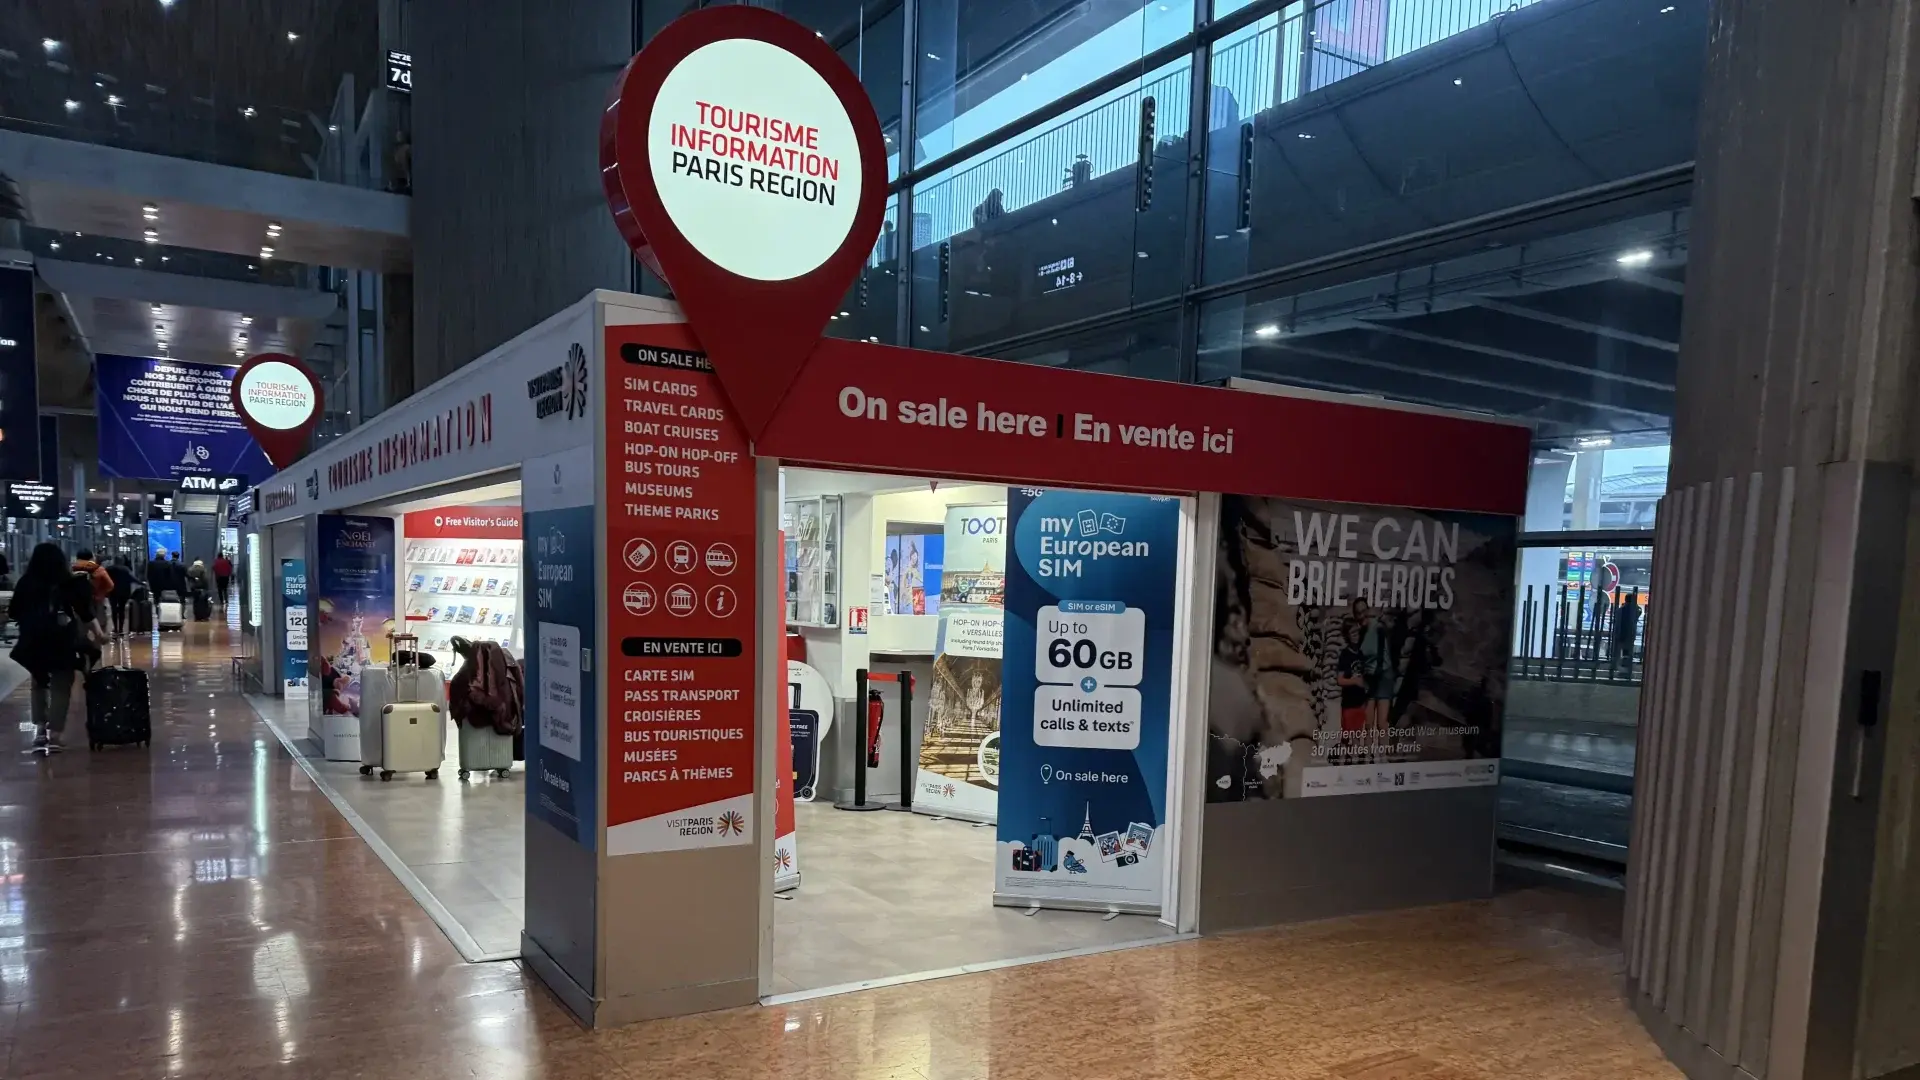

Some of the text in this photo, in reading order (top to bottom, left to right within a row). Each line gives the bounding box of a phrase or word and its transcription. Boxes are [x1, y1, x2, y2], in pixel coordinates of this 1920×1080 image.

[696, 100, 819, 151] TOURISME
[671, 123, 839, 181] INFORMATION
[672, 151, 835, 207] PARIS REGION
[0, 336, 17, 346] on
[638, 349, 657, 364] ON
[660, 352, 693, 368] SALE
[154, 365, 187, 374] DEPUIS
[188, 368, 200, 376] 80
[130, 379, 231, 395] CONTRIBUENT À QUEL
[145, 372, 232, 387] NOS 26 AÉROPORTS
[256, 382, 299, 392] TOURISME
[624, 377, 698, 397] SIM CARDS
[123, 394, 149, 402] NOUS
[157, 396, 169, 404] UN
[171, 398, 200, 407] FUTUR
[127, 387, 230, 402] CHOSE DE PLUS GRAND
[248, 389, 307, 400] INFORMATION
[250, 396, 306, 407] PARIS REGION
[139, 403, 157, 411] QUI
[158, 405, 184, 414] NOUS
[185, 408, 210, 416] REND
[624, 399, 724, 421] TRAVEL CARDS
[838, 385, 1234, 454] On sale here En vente ici
[624, 421, 719, 442] BOAT CRUISES
[328, 392, 492, 493] TOURISME INFORMATION
[624, 442, 738, 464] HOP-ON HOP-OFF
[625, 461, 700, 478] BUS TOURS
[181, 477, 216, 490] ATM
[625, 482, 693, 499] MUSEUMS
[625, 503, 719, 521] THEME PARKS
[445, 517, 519, 527] Free Visitor's Guide
[1041, 517, 1073, 537] my
[1293, 510, 1460, 564] WE CAN
[1040, 536, 1149, 560] European
[538, 561, 573, 586] European
[1038, 559, 1082, 578] SIM
[1287, 559, 1456, 610] BRIE HEROES
[538, 587, 552, 611] SIM
[1068, 602, 1083, 610] SIM
[1095, 603, 1116, 611] eSIM
[953, 619, 980, 627] HOP-ON
[1049, 620, 1088, 636] Up to
[967, 629, 1003, 637] VERSAILLES
[643, 641, 723, 654] EN VENTE ICI
[1048, 638, 1133, 670] 60 GB
[624, 669, 694, 682] CARTE SIM
[624, 689, 740, 702] PASS TRANSPORT
[1052, 699, 1124, 714] Unlimited
[624, 707, 701, 723] CROISIÈRES
[1040, 718, 1075, 731] calls
[1078, 719, 1089, 731] &
[624, 728, 744, 743] BUS TOURISTIQUES
[1312, 725, 1480, 741] Experience the Great War museum
[624, 748, 678, 763] MUSÉES
[1311, 741, 1421, 757] 30 minutes from Paris
[624, 765, 734, 783] PARCS À THÈMES
[1056, 770, 1129, 783] On sale here
[679, 826, 714, 836] REGION
